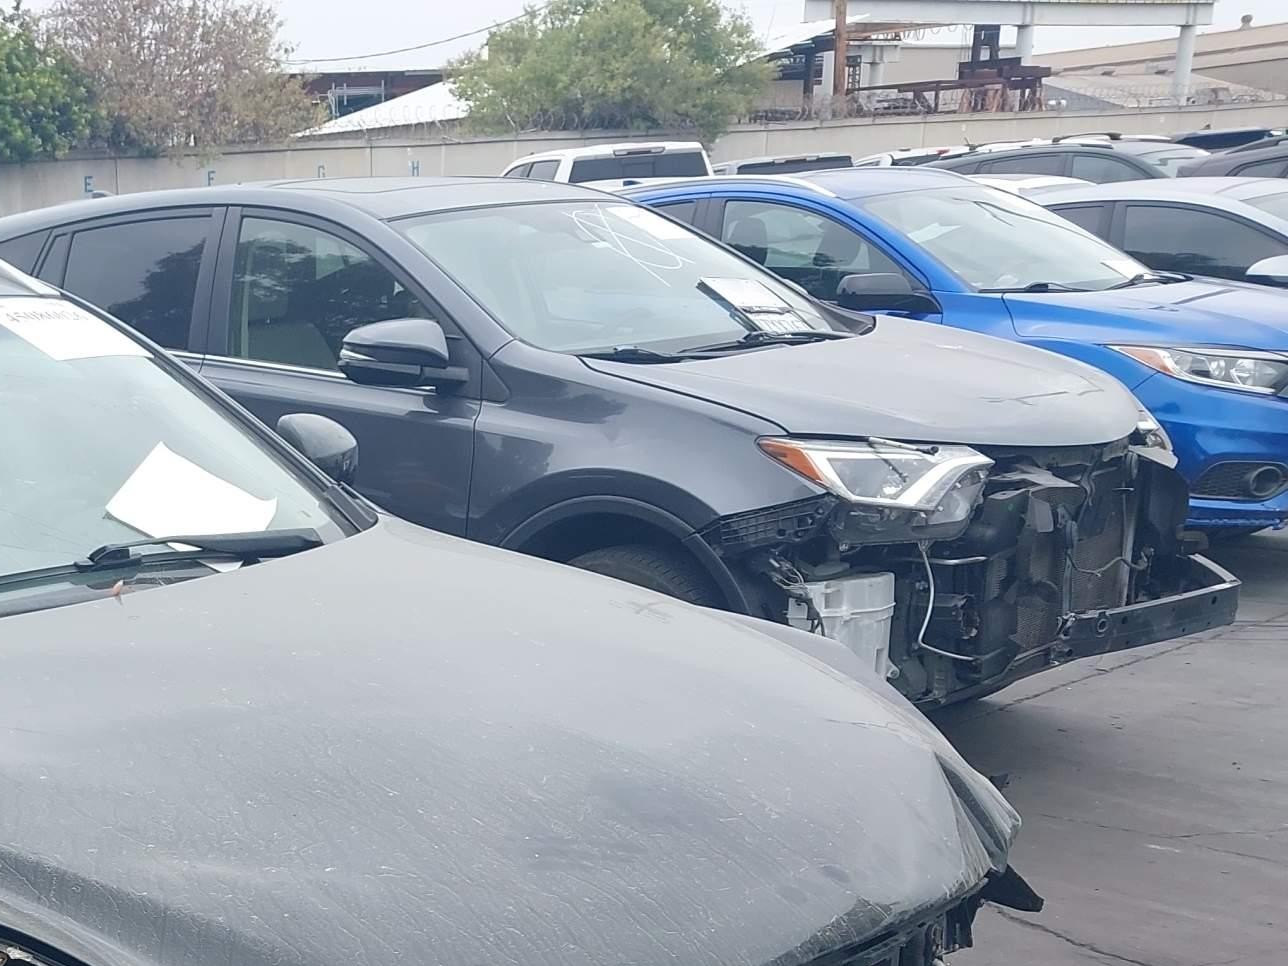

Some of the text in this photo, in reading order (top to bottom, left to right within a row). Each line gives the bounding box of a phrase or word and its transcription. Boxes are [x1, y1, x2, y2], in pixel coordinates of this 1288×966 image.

[412, 160, 420, 177] H
[84, 175, 94, 193] E
[207, 170, 216, 187] F
